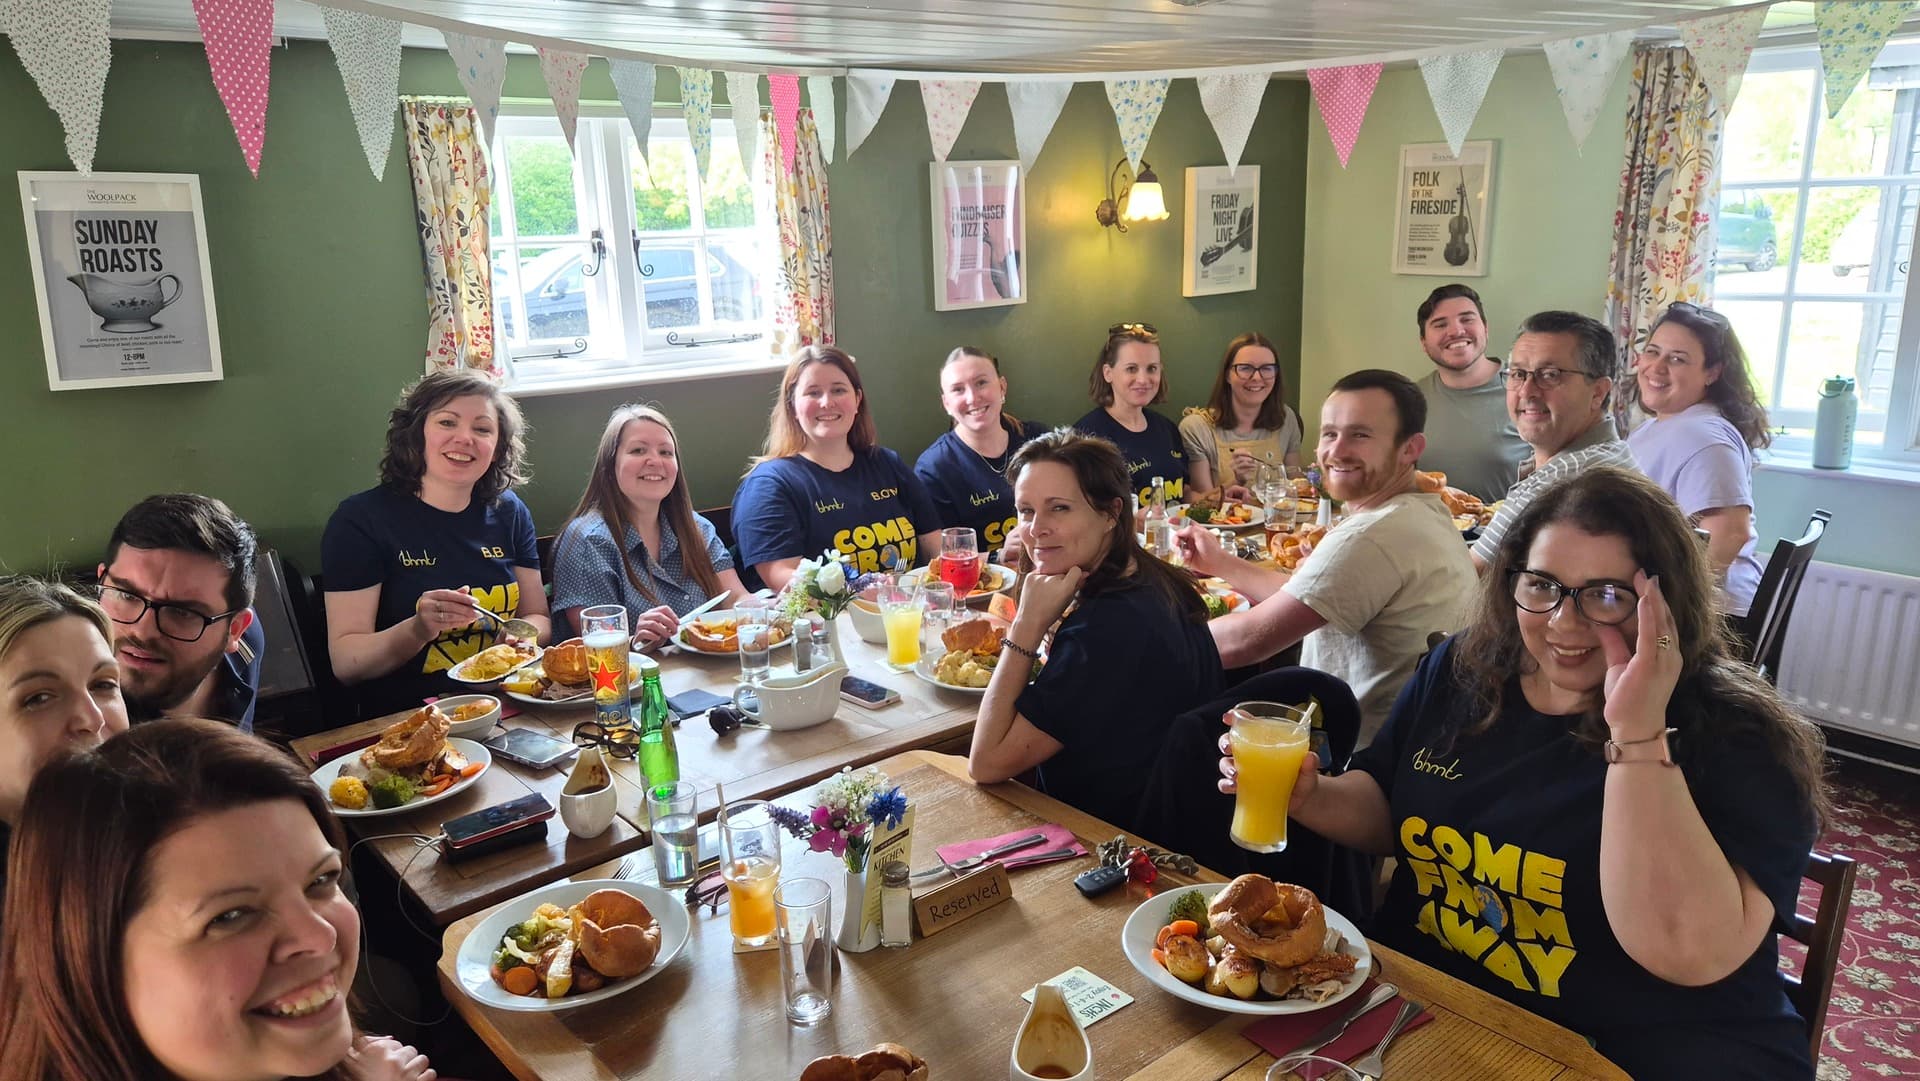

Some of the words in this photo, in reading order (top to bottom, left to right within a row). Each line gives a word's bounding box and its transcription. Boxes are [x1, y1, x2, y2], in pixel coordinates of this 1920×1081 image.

[1413, 171, 1440, 187] FOLK
[87, 193, 137, 201] WOOLPACK
[1211, 193, 1240, 209] FRIDAY
[1411, 189, 1420, 198] BY
[1421, 189, 1433, 198] THE
[1410, 200, 1457, 215] FIRESIDE
[1213, 210, 1237, 226] NIGHT
[75, 220, 158, 244] SUNDAY
[951, 221, 989, 238] QUIZZS
[1215, 227, 1233, 242] LIVE
[80, 248, 163, 272] ROASTS
[833, 516, 916, 554] COME
[984, 516, 1018, 544] CO
[481, 546, 504, 558] B.B
[470, 581, 520, 613] ME
[1400, 816, 1567, 909] COME
[928, 876, 1001, 924] Reserved
[1408, 857, 1574, 949] FROM
[1415, 899, 1577, 998] AWAY
